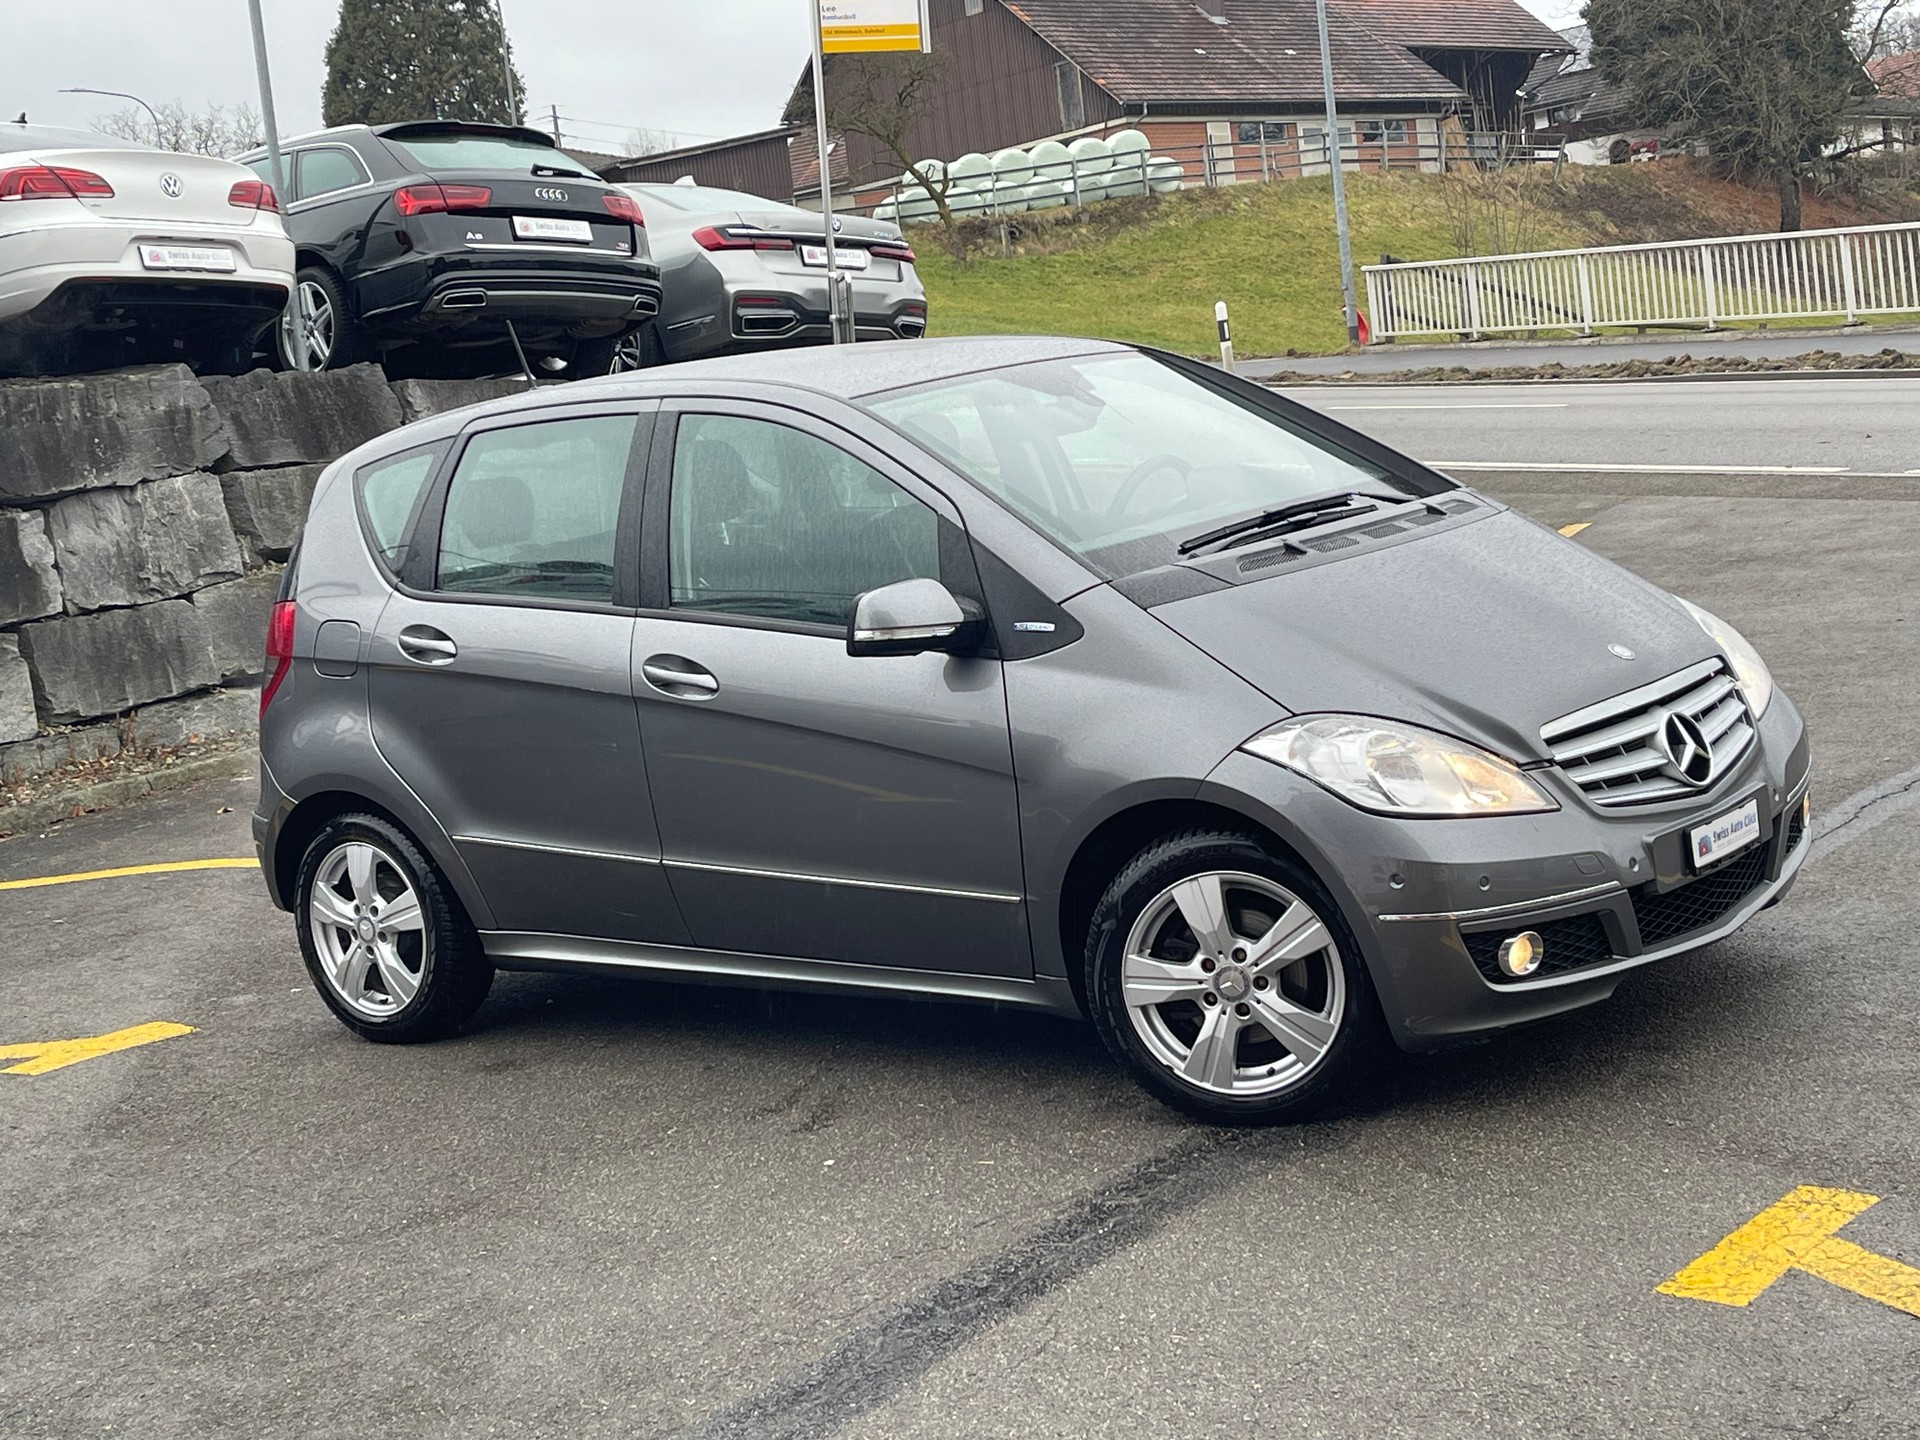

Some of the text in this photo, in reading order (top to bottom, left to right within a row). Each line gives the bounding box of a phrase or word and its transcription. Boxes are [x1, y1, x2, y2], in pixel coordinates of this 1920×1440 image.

[555, 223, 570, 232] Auto
[167, 250, 190, 260] Swiss
[191, 251, 210, 261] Auto
[1713, 827, 1729, 843] Swiss
[1730, 820, 1743, 834] Auto
